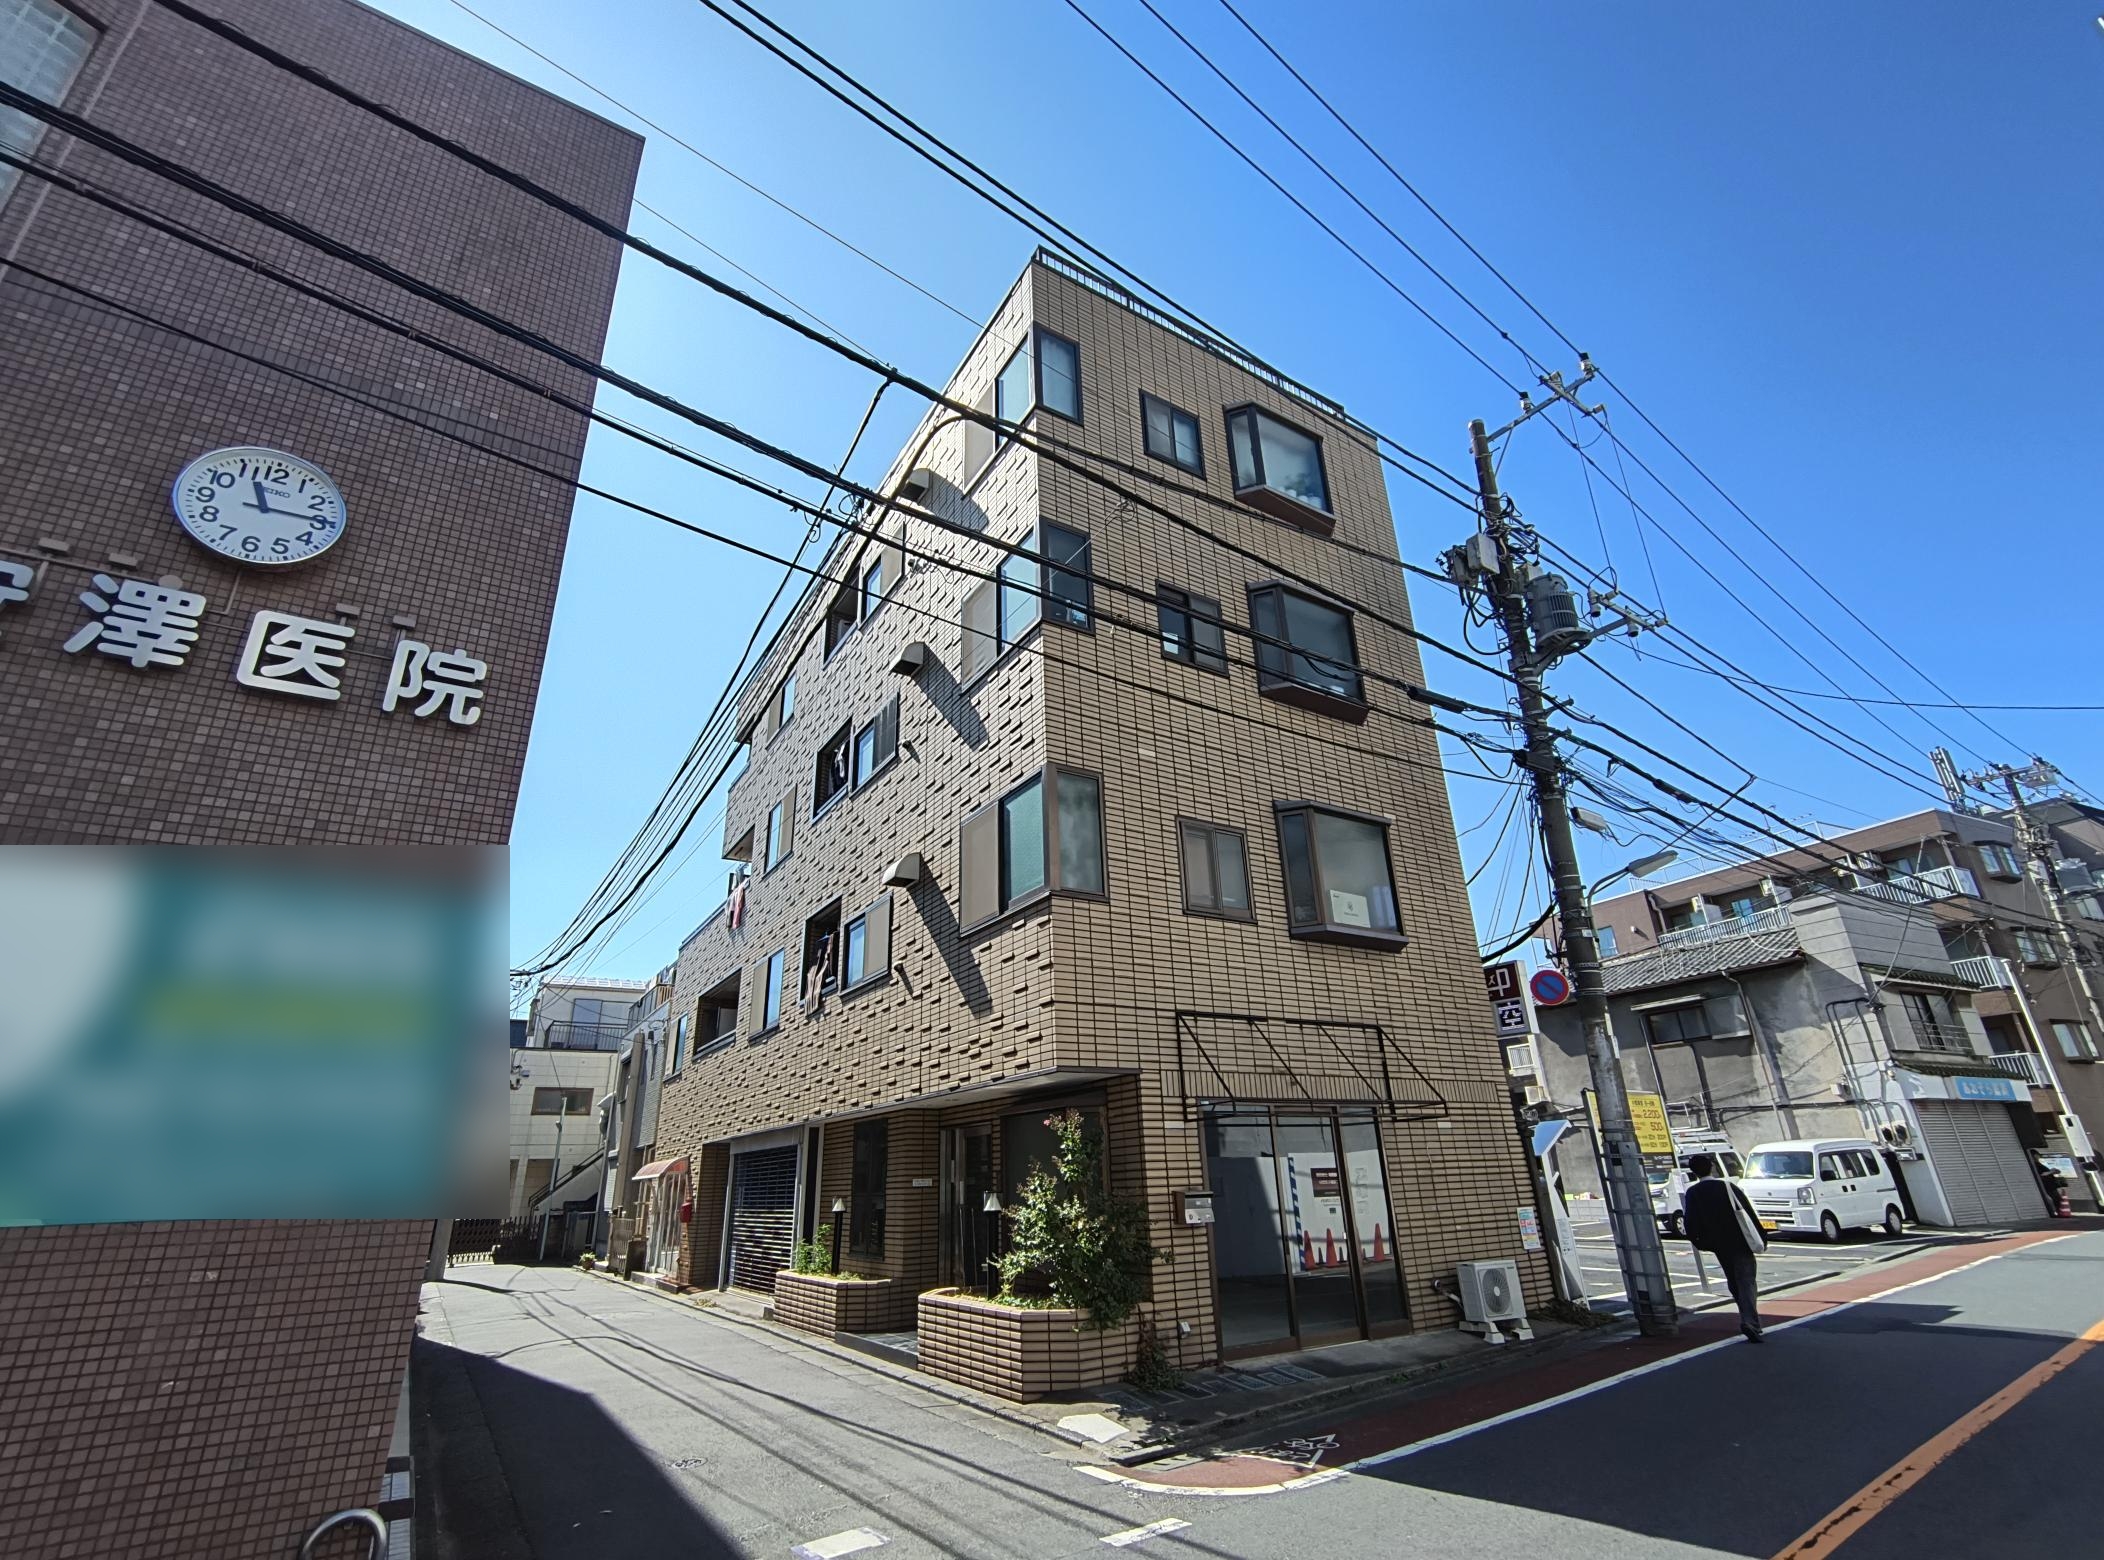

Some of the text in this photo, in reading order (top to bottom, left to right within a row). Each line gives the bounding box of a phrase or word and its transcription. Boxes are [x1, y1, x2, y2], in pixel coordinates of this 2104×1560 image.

[209, 470, 235, 489] 10
[239, 462, 260, 481] 11
[264, 465, 290, 485] 12
[195, 486, 216, 503] 9
[298, 478, 307, 494] 1
[307, 495, 326, 512] 2
[199, 505, 220, 523] 8
[309, 514, 328, 531] 3
[218, 524, 238, 541] 7
[295, 531, 314, 546] 4
[241, 535, 261, 553] 6
[270, 537, 290, 555] 5
[0, 559, 489, 726] 澤医院
